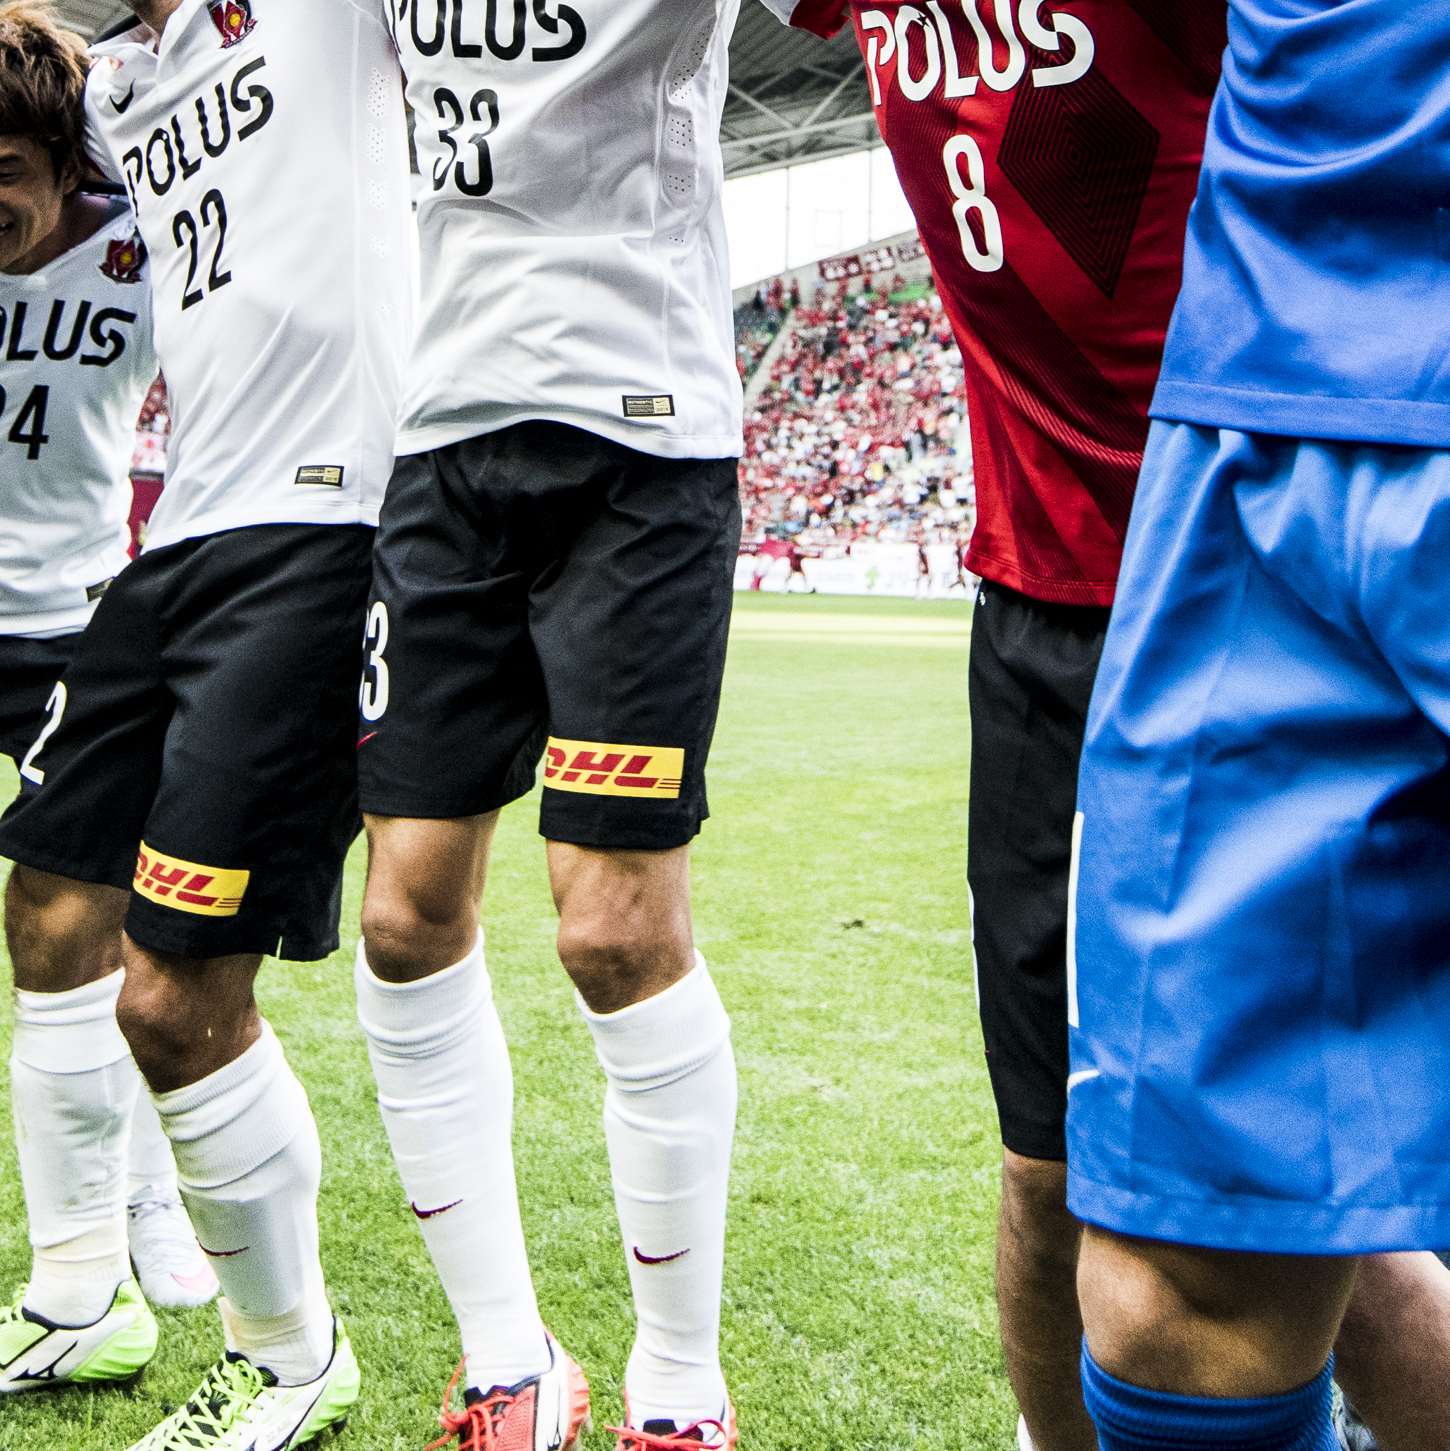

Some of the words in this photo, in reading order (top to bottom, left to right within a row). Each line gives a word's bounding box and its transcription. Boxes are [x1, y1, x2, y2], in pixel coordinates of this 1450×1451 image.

[123, 55, 274, 218] POLUS
[433, 87, 501, 197] 33
[172, 188, 232, 312] 22
[942, 134, 1004, 273] 8
[359, 600, 390, 723] 3
[546, 746, 659, 789] DHL
